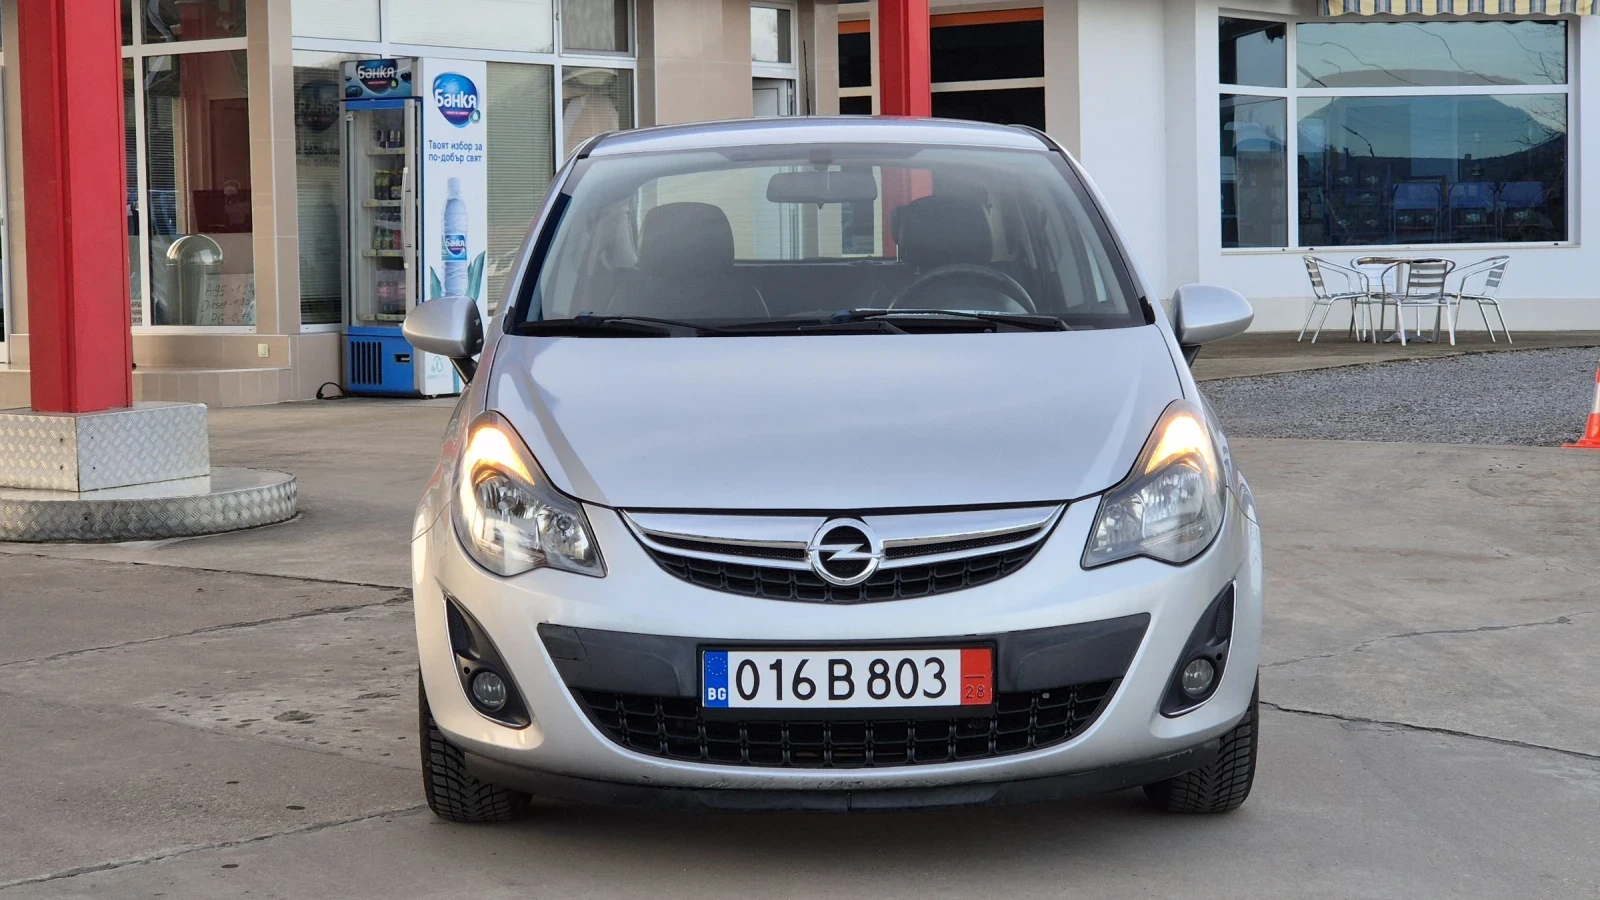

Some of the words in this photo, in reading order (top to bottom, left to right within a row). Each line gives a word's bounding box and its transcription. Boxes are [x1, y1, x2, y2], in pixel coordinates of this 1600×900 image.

[428, 139, 449, 150] Твоят
[451, 140, 473, 152] избор
[474, 143, 483, 151] за
[428, 152, 465, 164] по-добър
[466, 154, 482, 163] свят
[707, 687, 727, 700] BG
[964, 684, 986, 699] 28
